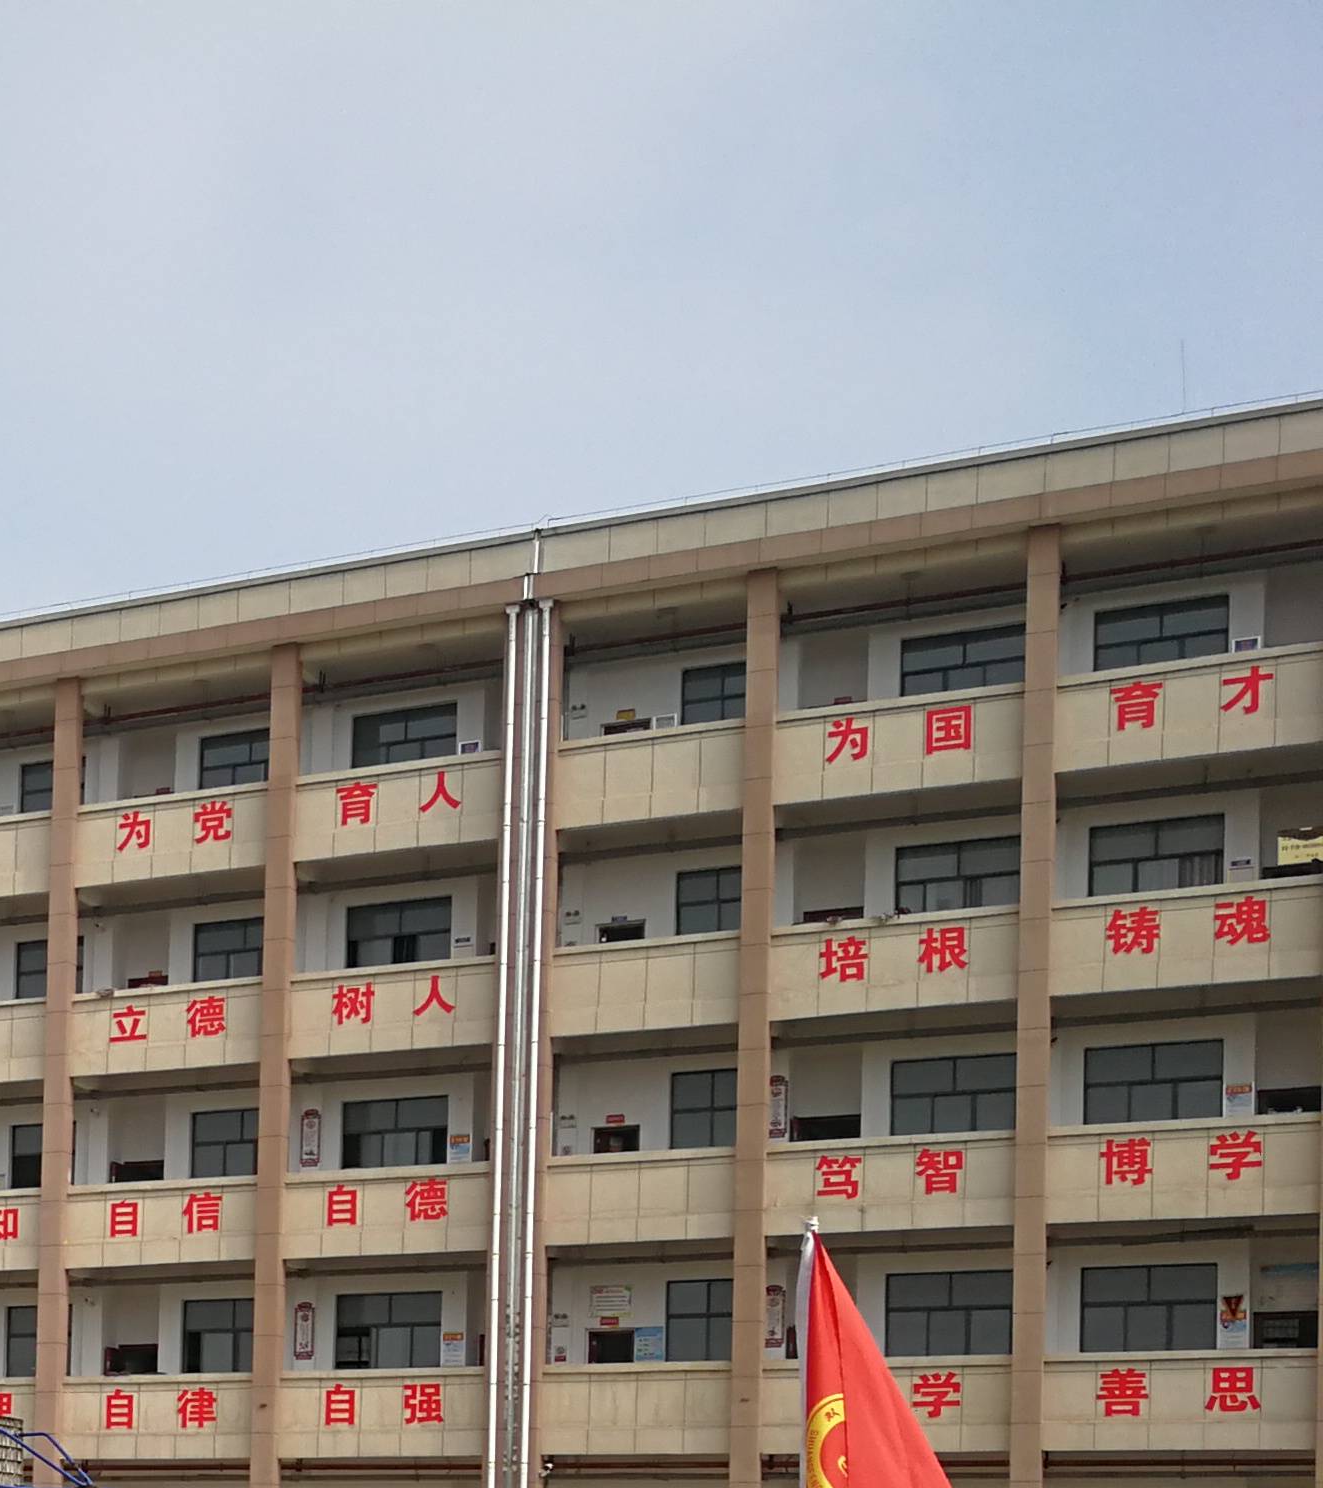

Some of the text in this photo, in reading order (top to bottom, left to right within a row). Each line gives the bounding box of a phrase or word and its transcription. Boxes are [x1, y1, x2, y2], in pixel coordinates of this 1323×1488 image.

[826, 666, 1274, 763] 为国 育才
[117, 772, 461, 852] 为党 育人
[820, 896, 1271, 982] 培根 铸魂
[110, 976, 456, 1044] 立德 树人
[816, 1131, 1262, 1199] 笃智 博学
[110, 1192, 223, 1238] 自信
[326, 1179, 448, 1227] 自德
[105, 1388, 218, 1430] 自律
[325, 1383, 444, 1426] 自强
[1097, 1367, 1262, 1417] 善思
